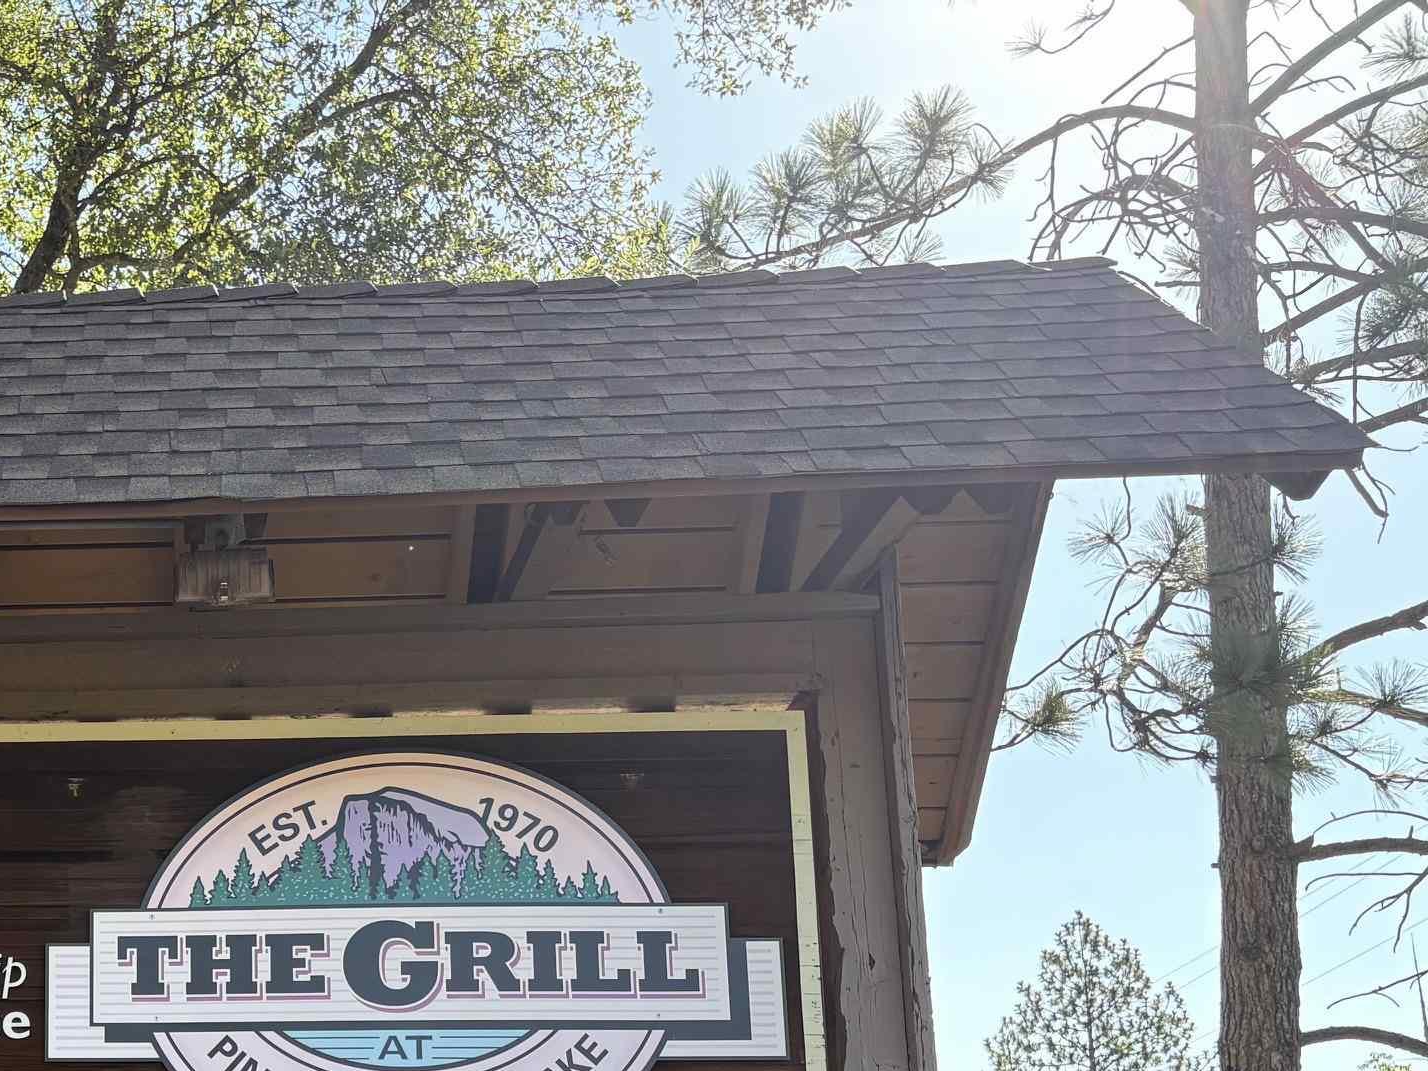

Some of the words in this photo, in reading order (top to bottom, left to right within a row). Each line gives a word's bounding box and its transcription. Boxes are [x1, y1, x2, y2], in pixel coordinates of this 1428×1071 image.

[247, 798, 329, 856] EST.
[476, 796, 559, 854] 1970
[117, 933, 332, 1001] THE
[342, 919, 707, 1013] GRILL
[377, 1034, 433, 1061] AT
